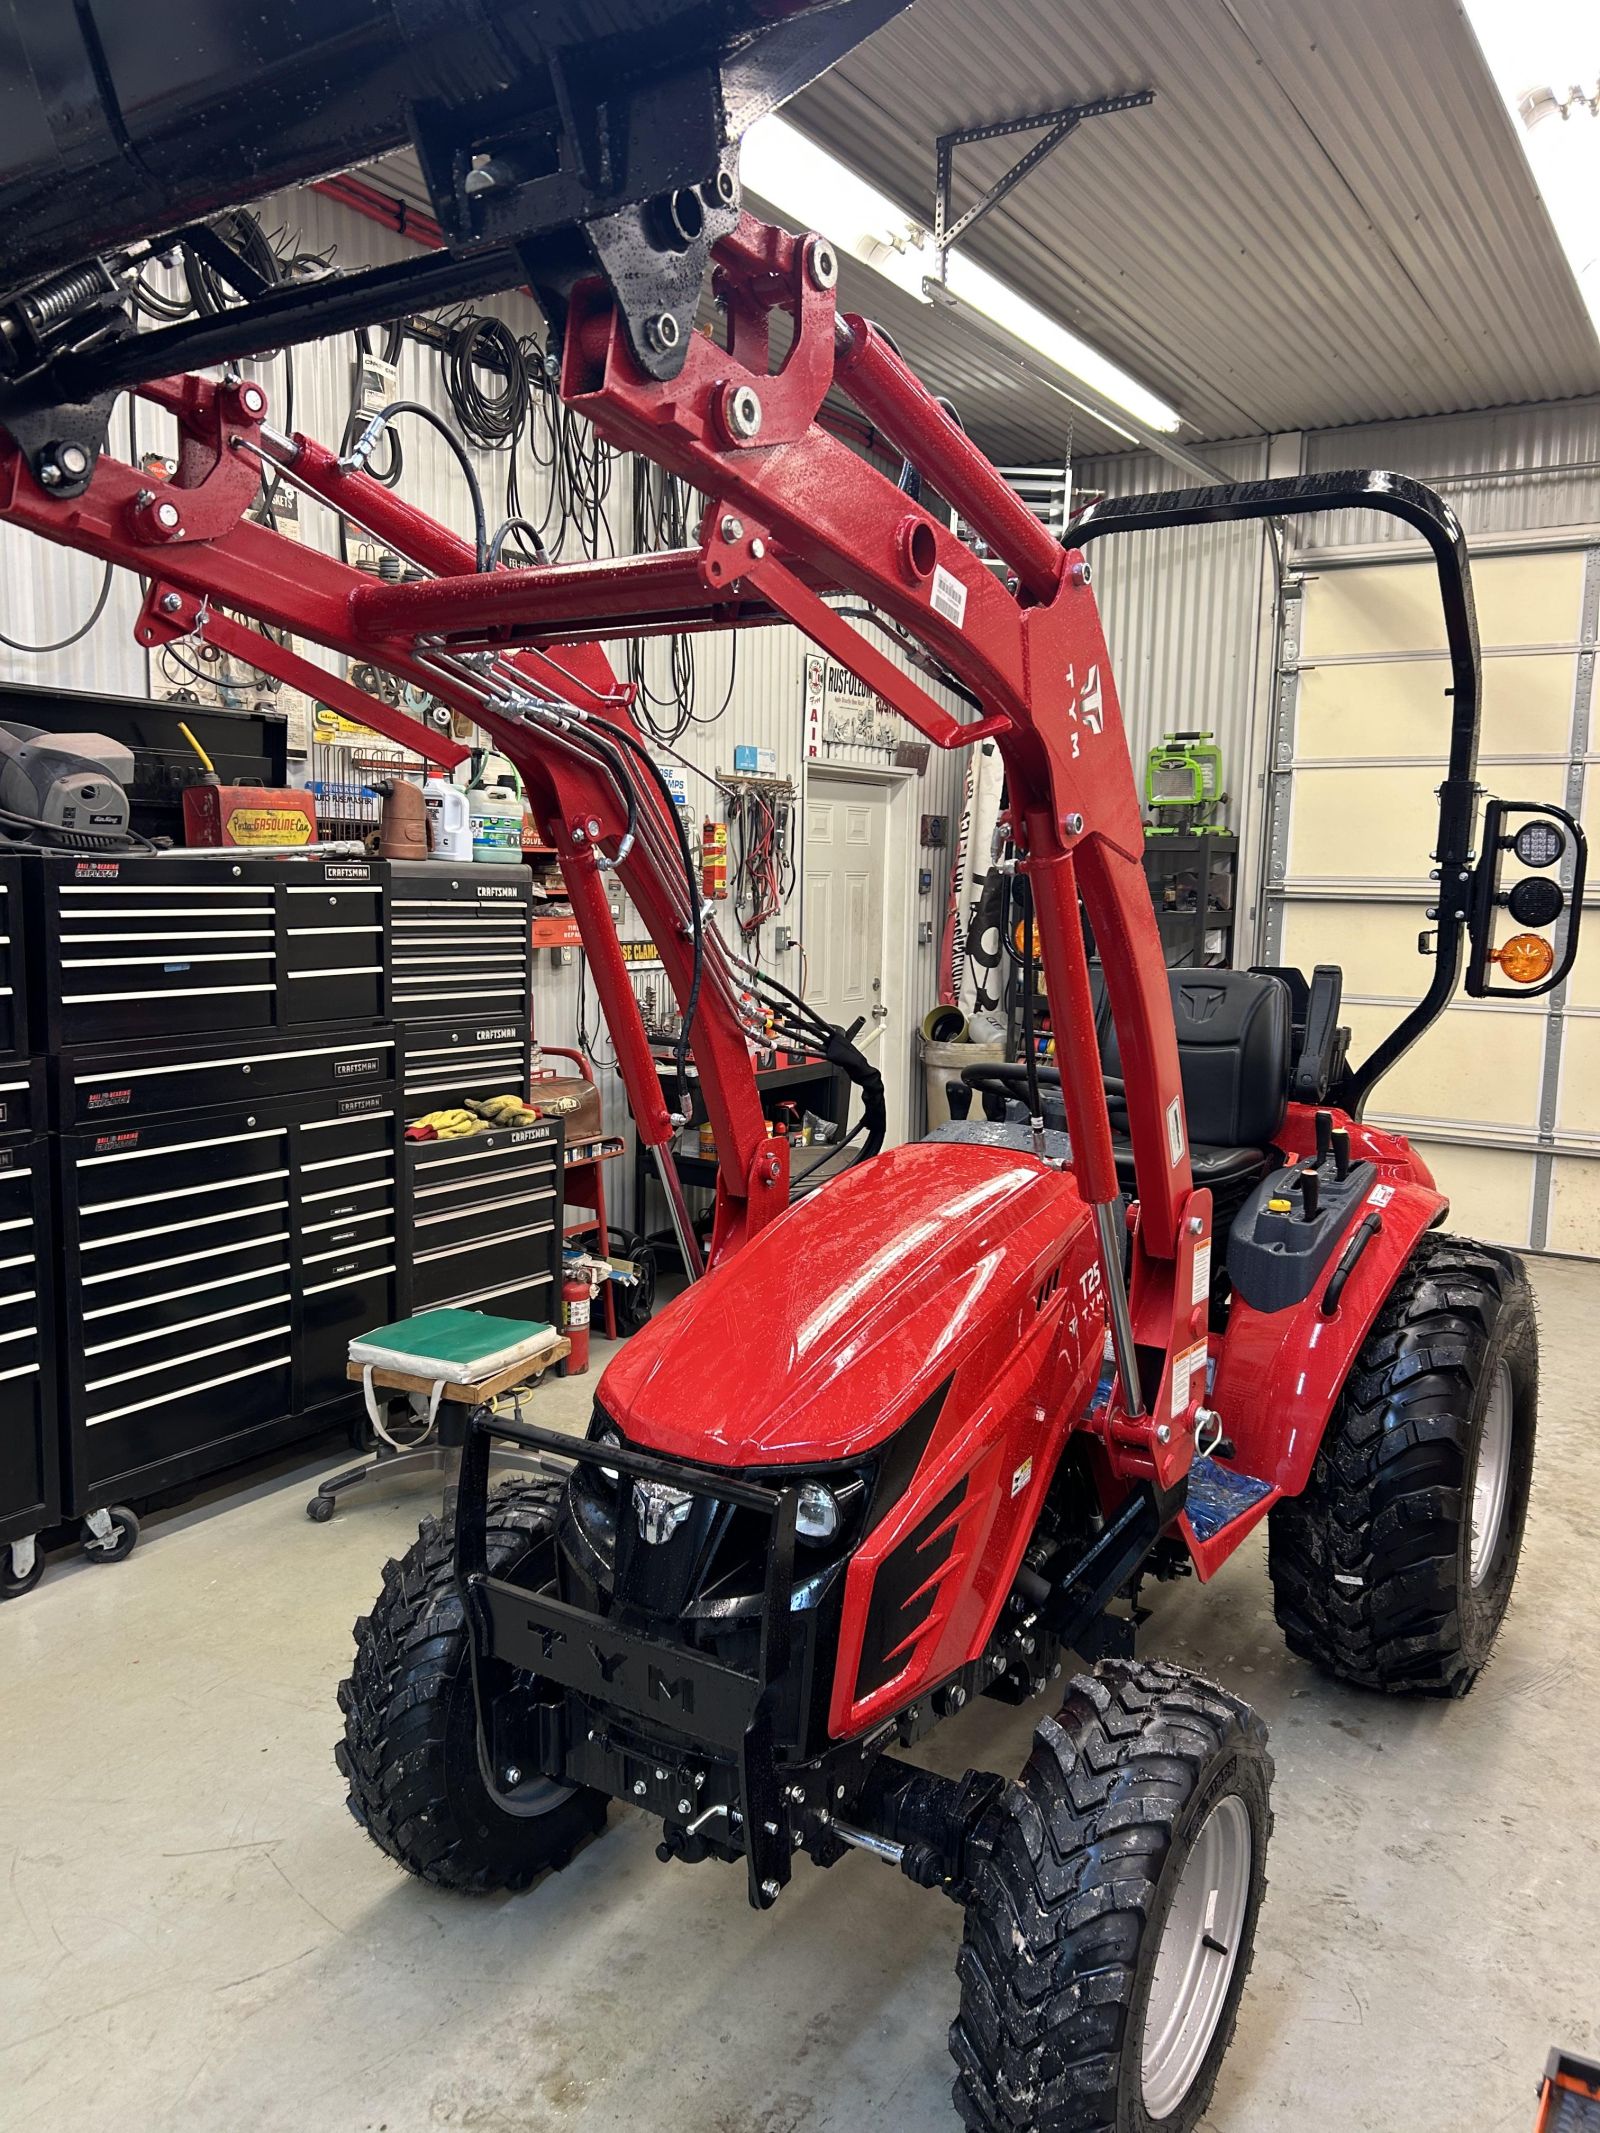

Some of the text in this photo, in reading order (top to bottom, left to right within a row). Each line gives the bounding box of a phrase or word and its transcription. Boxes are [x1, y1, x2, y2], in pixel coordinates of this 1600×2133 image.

[272, 494, 293, 509] SKETS
[827, 666, 873, 699] RUST-OLEUM
[1065, 663, 1080, 759] TYM
[521, 837, 543, 846] SOLVE
[328, 867, 368, 878] CRAFTSMAN
[477, 886, 518, 897] CRAFTSMAN
[563, 931, 582, 939] REPAI
[621, 944, 633, 961] SE
[476, 1027, 516, 1041] CRAFTSMAN
[337, 1061, 377, 1074] CRAFTSMAN
[341, 1098, 380, 1112] CRAFTSMAN
[511, 1126, 550, 1143] CRAFTSMAN
[1079, 1259, 1101, 1301] T25
[1081, 1289, 1104, 1321] TYM
[527, 1619, 694, 1715] TYM
